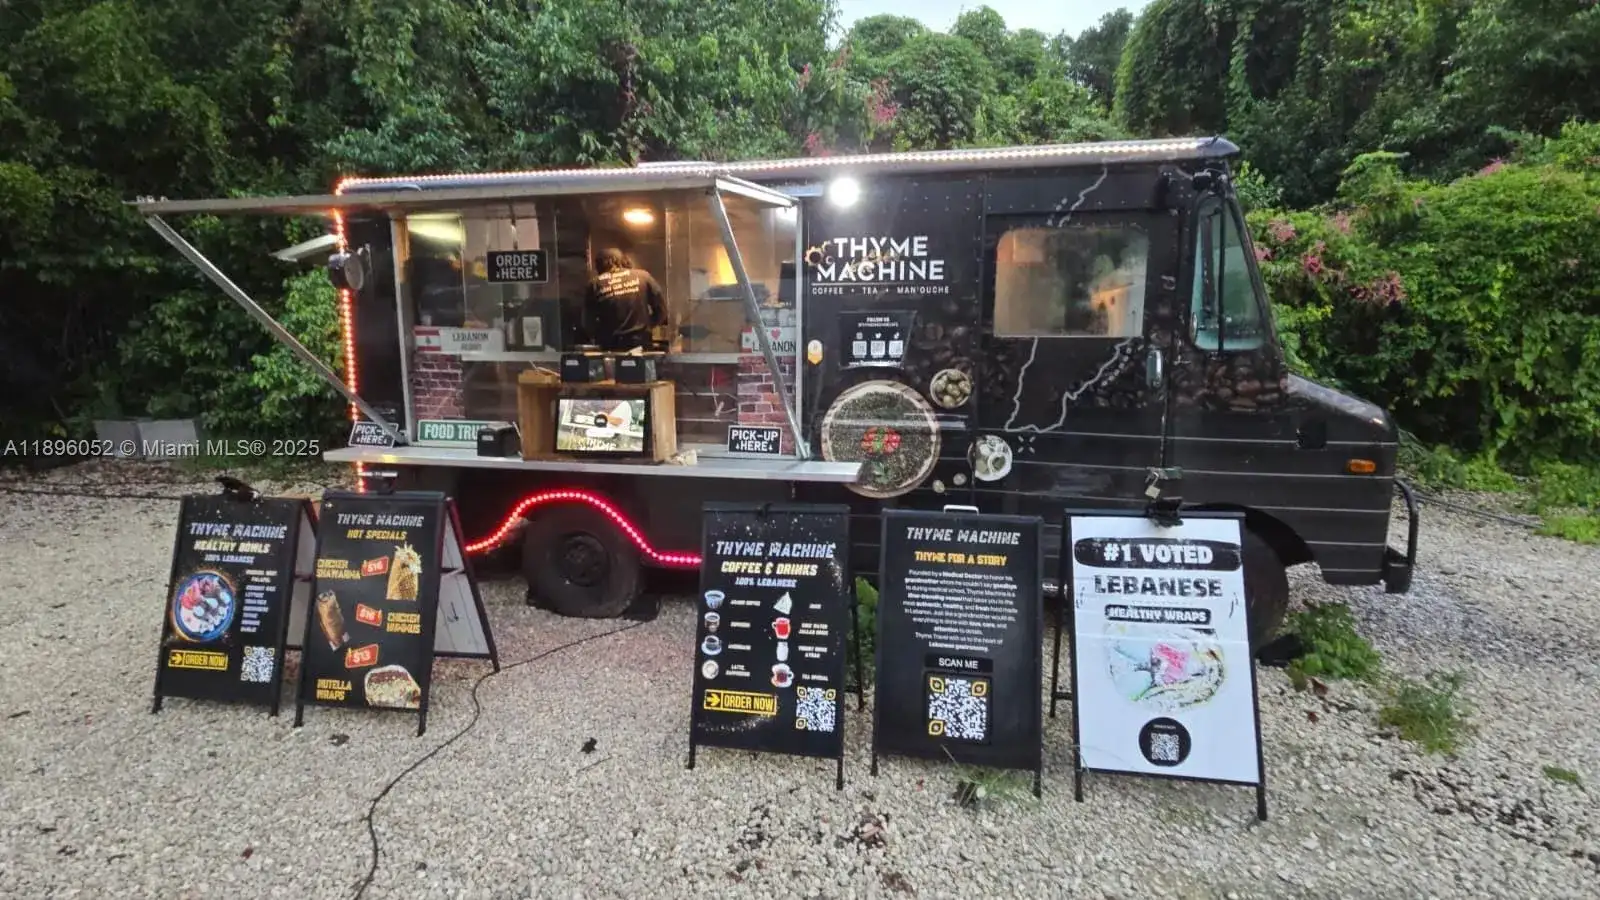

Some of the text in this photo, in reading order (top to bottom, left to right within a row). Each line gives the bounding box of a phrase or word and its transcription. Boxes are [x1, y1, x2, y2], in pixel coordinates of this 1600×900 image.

[833, 235, 929, 258] THYME
[496, 254, 538, 266] ORDER
[501, 267, 533, 279] HERE
[817, 260, 945, 282] MACHINE
[812, 287, 844, 295] COFFEE
[862, 287, 878, 295] TEA
[452, 332, 489, 343] LEBANON
[425, 424, 455, 439] FOOD
[731, 429, 778, 442] PICK-UP
[360, 434, 384, 444] HERE
[740, 441, 769, 452] HERE
[337, 513, 425, 527] THYME MACHINE
[190, 522, 288, 539] THYME MACHINE
[346, 529, 408, 541] HOT SPECIALS
[906, 527, 1021, 545] THYME MACHINE
[193, 539, 237, 552] HEALTHY
[715, 540, 837, 559] THYME MACHINE
[914, 550, 1007, 567] THYME FOR A STORY
[1103, 543, 1214, 564] #1 VOTED
[317, 558, 349, 568] CHICKEN
[721, 561, 761, 574] COFFEE
[776, 563, 819, 576] DRINKS
[316, 568, 361, 579] SHAWARMA
[734, 576, 798, 588] 100% LEBANESE
[904, 576, 939, 585] grandmother
[1094, 574, 1223, 597] LEBANESE
[387, 612, 421, 623] CHICKEN
[1107, 605, 1207, 622] HEALTHY WRAPS
[184, 655, 226, 667] ORDER NOW
[938, 657, 979, 669] SCAN ME
[317, 679, 352, 690] NUTELLA
[316, 689, 345, 700] WRAPS
[724, 695, 774, 712] ORDER NOW
